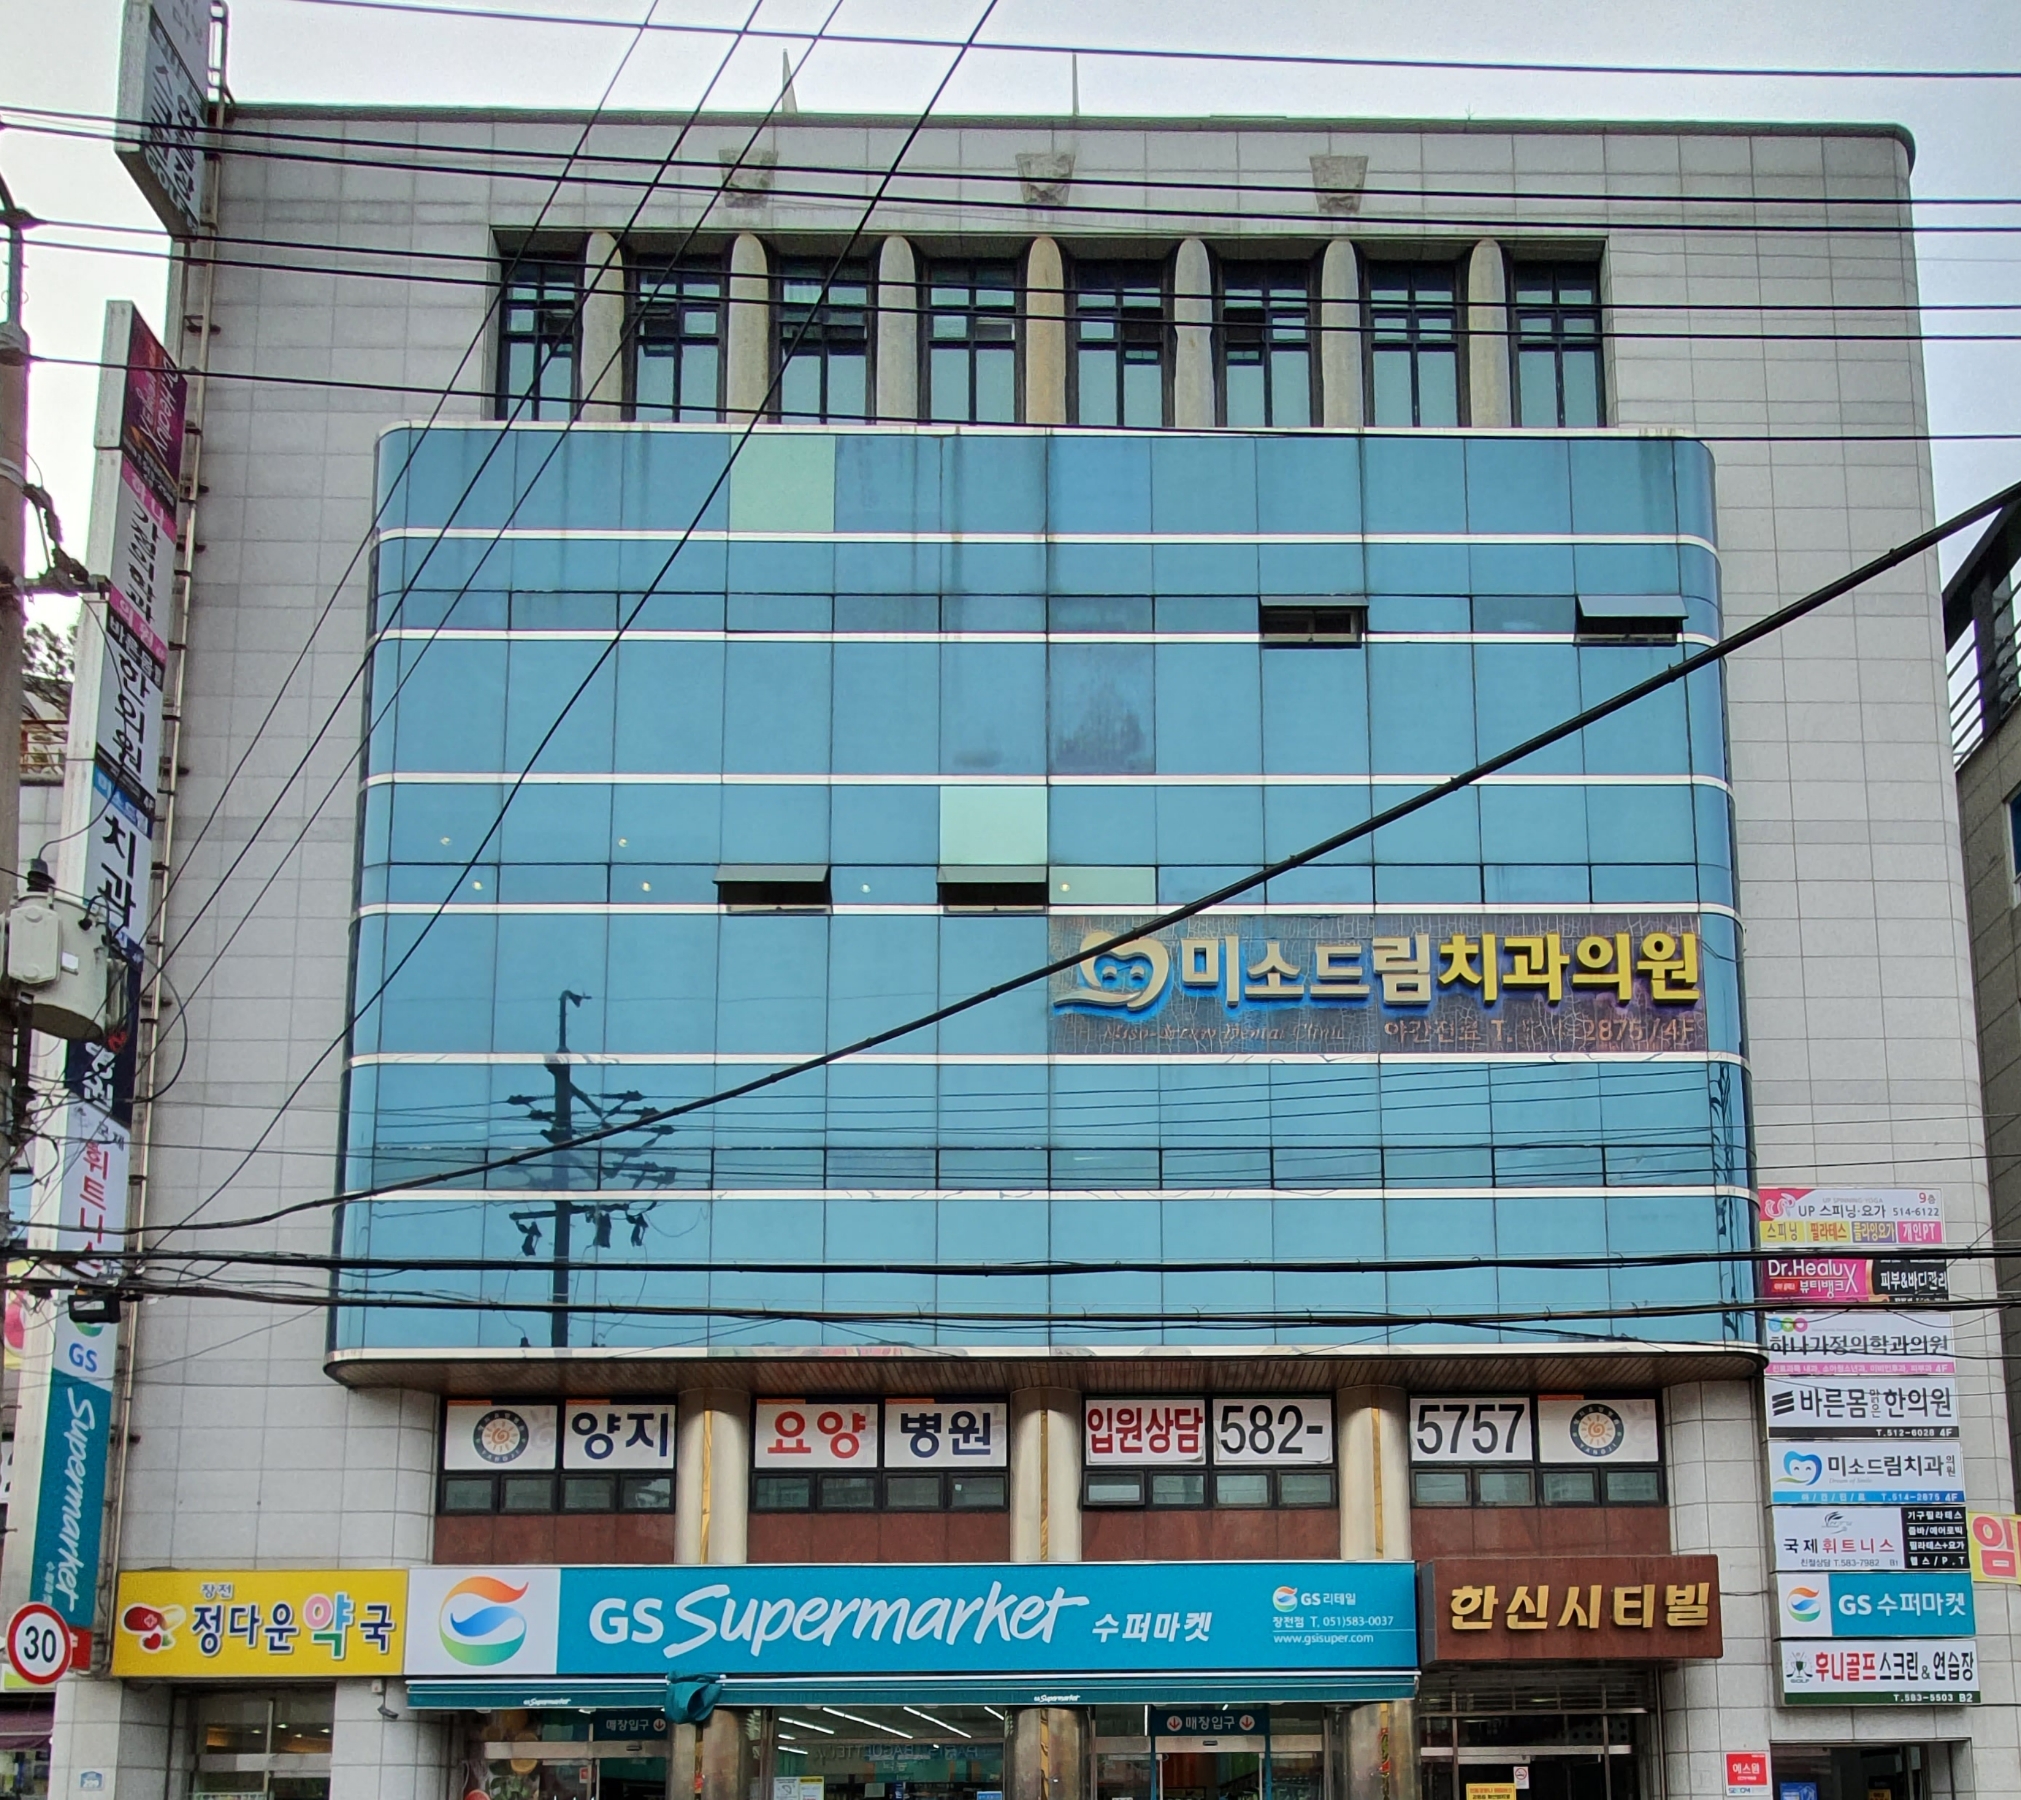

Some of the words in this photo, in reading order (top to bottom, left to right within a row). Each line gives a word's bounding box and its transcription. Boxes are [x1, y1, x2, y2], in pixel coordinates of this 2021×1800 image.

[126, 499, 161, 624] 가정의학과
[112, 652, 150, 783] 한의원
[97, 813, 136, 928] 치과
[1798, 1206, 1815, 1217] UP
[1892, 1207, 1939, 1217] 514-6122
[1766, 1223, 1797, 1241] 스피닝
[1810, 1222, 1848, 1241] 필라테스
[1903, 1222, 1936, 1242] 개인PT
[1799, 1280, 1845, 1298] 뷰티뱅크
[1880, 1271, 1948, 1291] 피부&바디관리
[1769, 1335, 1949, 1356] 하나가정의학과의원
[68, 1343, 98, 1372] GS
[1935, 1364, 1948, 1373] 4F
[1801, 1387, 1868, 1418] 바른몸
[1884, 1387, 1952, 1418] 한의원
[571, 1411, 669, 1460] 양지
[767, 1410, 866, 1460] 요양
[900, 1410, 991, 1459] 병원
[1087, 1408, 1204, 1455] 입원상담
[1416, 1403, 1525, 1455] 5757
[1939, 1427, 1953, 1437] 4F
[1828, 1454, 1944, 1478] 미소드림치과
[55, 1387, 96, 1613] Supermarket
[1945, 1493, 1959, 1502] 4F
[1972, 1515, 2021, 1578] 임
[200, 1582, 234, 1600] 장전
[1300, 1593, 1321, 1605] GS
[1323, 1592, 1356, 1606] 리테일
[1450, 1581, 1711, 1631] 한신시티빌
[1838, 1594, 1872, 1616] GS
[1877, 1593, 1966, 1618] 수퍼마켓
[191, 1592, 395, 1660] 정다운약국
[588, 1597, 664, 1644] GS
[663, 1581, 1090, 1659] Supermarket
[1091, 1611, 1212, 1643] 수퍼마켓
[1272, 1616, 1304, 1629] 장전점
[1322, 1615, 1394, 1629] 051)583-0037
[23, 1626, 57, 1664] 30
[1273, 1633, 1374, 1646] www.gsisuper.com
[1958, 1693, 1973, 1703] B2
[605, 1718, 650, 1731] 매장입구
[1185, 1715, 1236, 1730] 매장입구
[1732, 1762, 1760, 1774] 에스원
